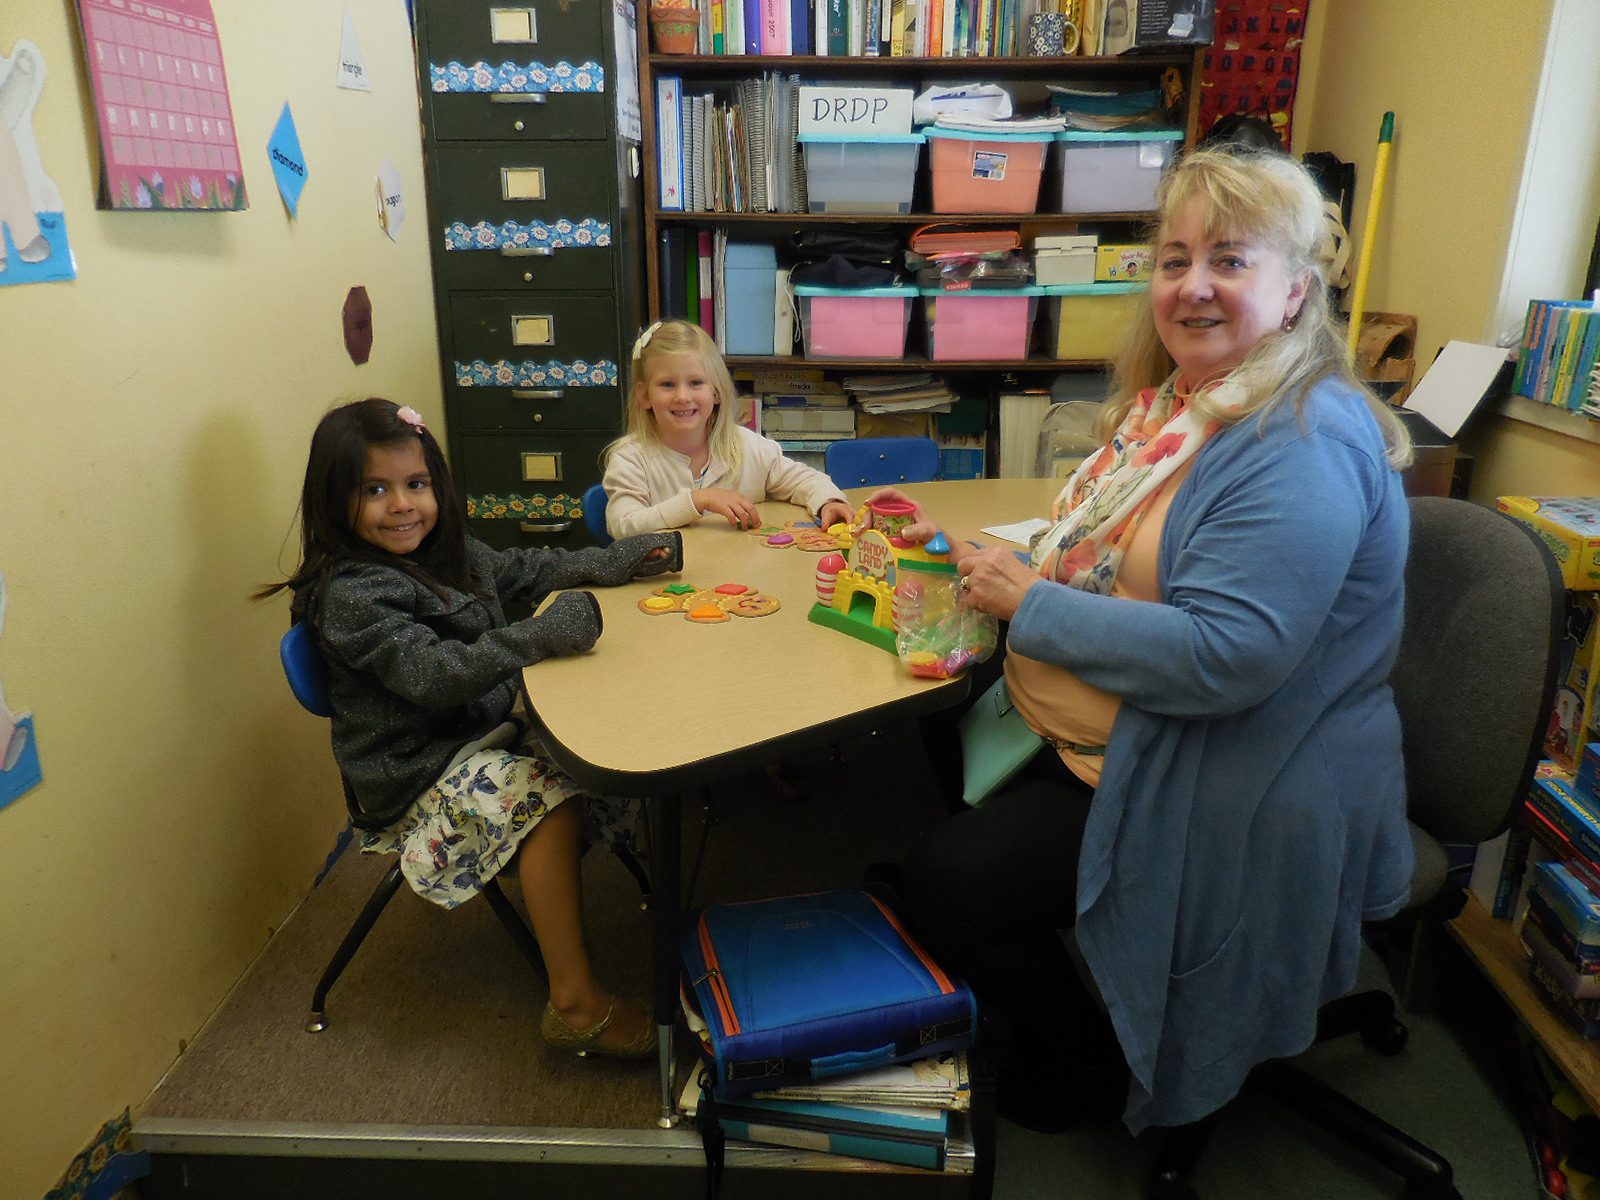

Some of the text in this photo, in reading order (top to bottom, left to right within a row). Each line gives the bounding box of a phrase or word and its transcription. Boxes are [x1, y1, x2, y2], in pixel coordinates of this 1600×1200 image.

[812, 97, 888, 124] DRDP
[272, 146, 304, 176] diamond
[857, 540, 889, 559] CANDY
[858, 552, 882, 570] LAND
